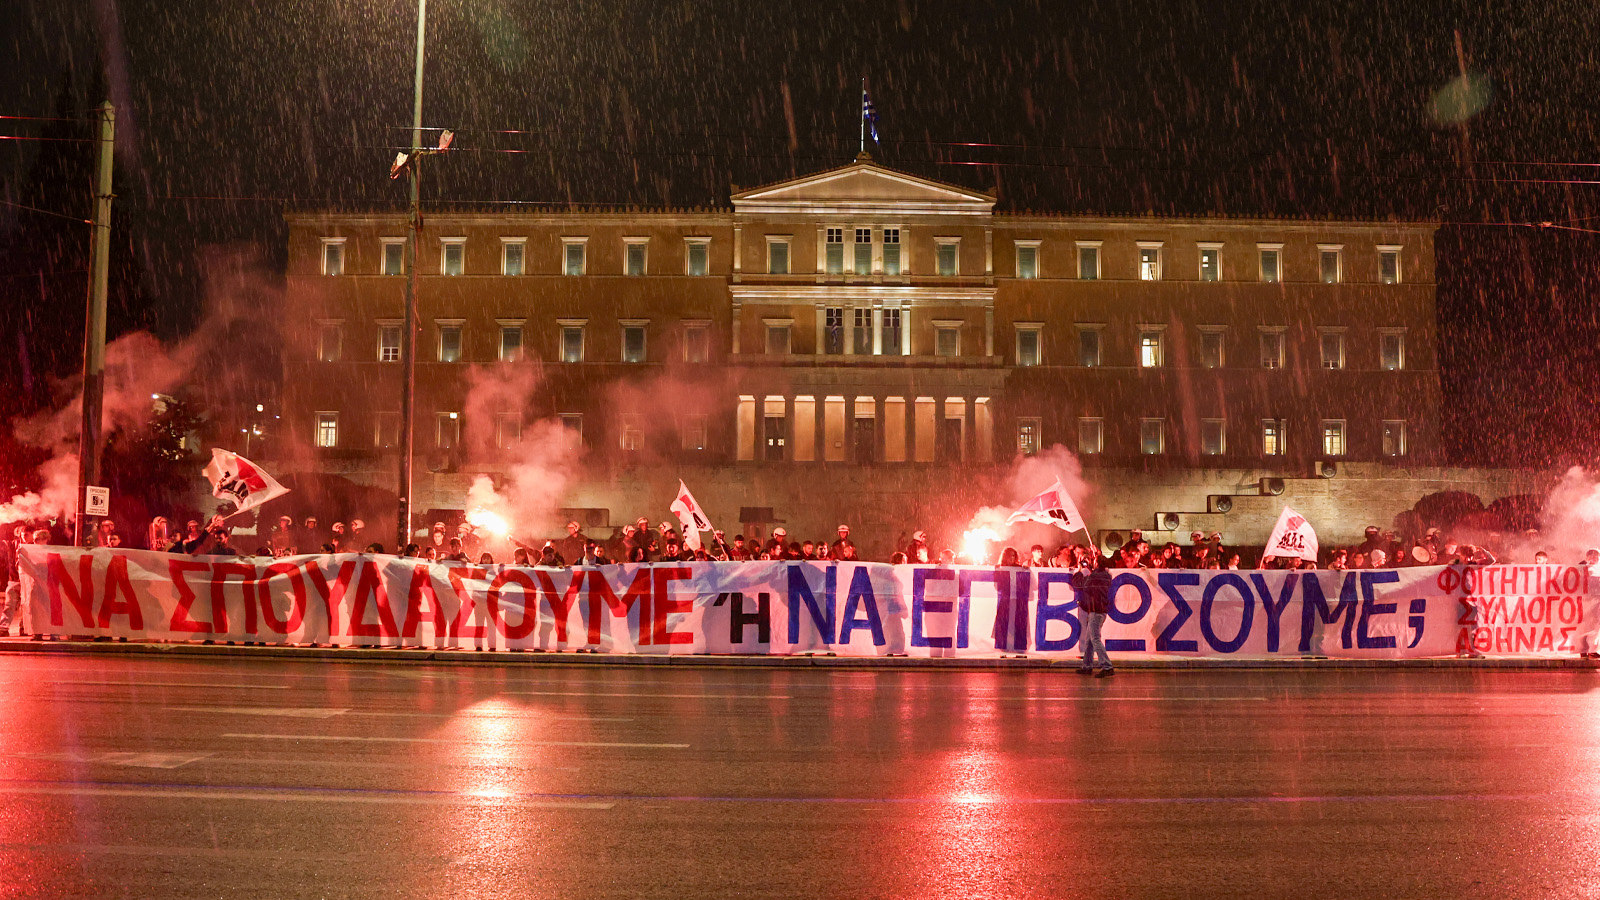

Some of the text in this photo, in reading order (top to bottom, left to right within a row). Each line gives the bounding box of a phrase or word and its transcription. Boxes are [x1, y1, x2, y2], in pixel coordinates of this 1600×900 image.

[1437, 566, 1589, 595] ΦΟΙΤΗΤΙΚΟΙ
[46, 552, 144, 630] ΝΑ
[168, 558, 694, 646] ΣΠΟΥΔΑΣΟΥΜΕ
[787, 565, 887, 646] ΝΑ
[1457, 596, 1584, 626] ΣΥΛΛΟΓΟΙ
[1456, 626, 1577, 653] ΑΘΗΝΑΣ
